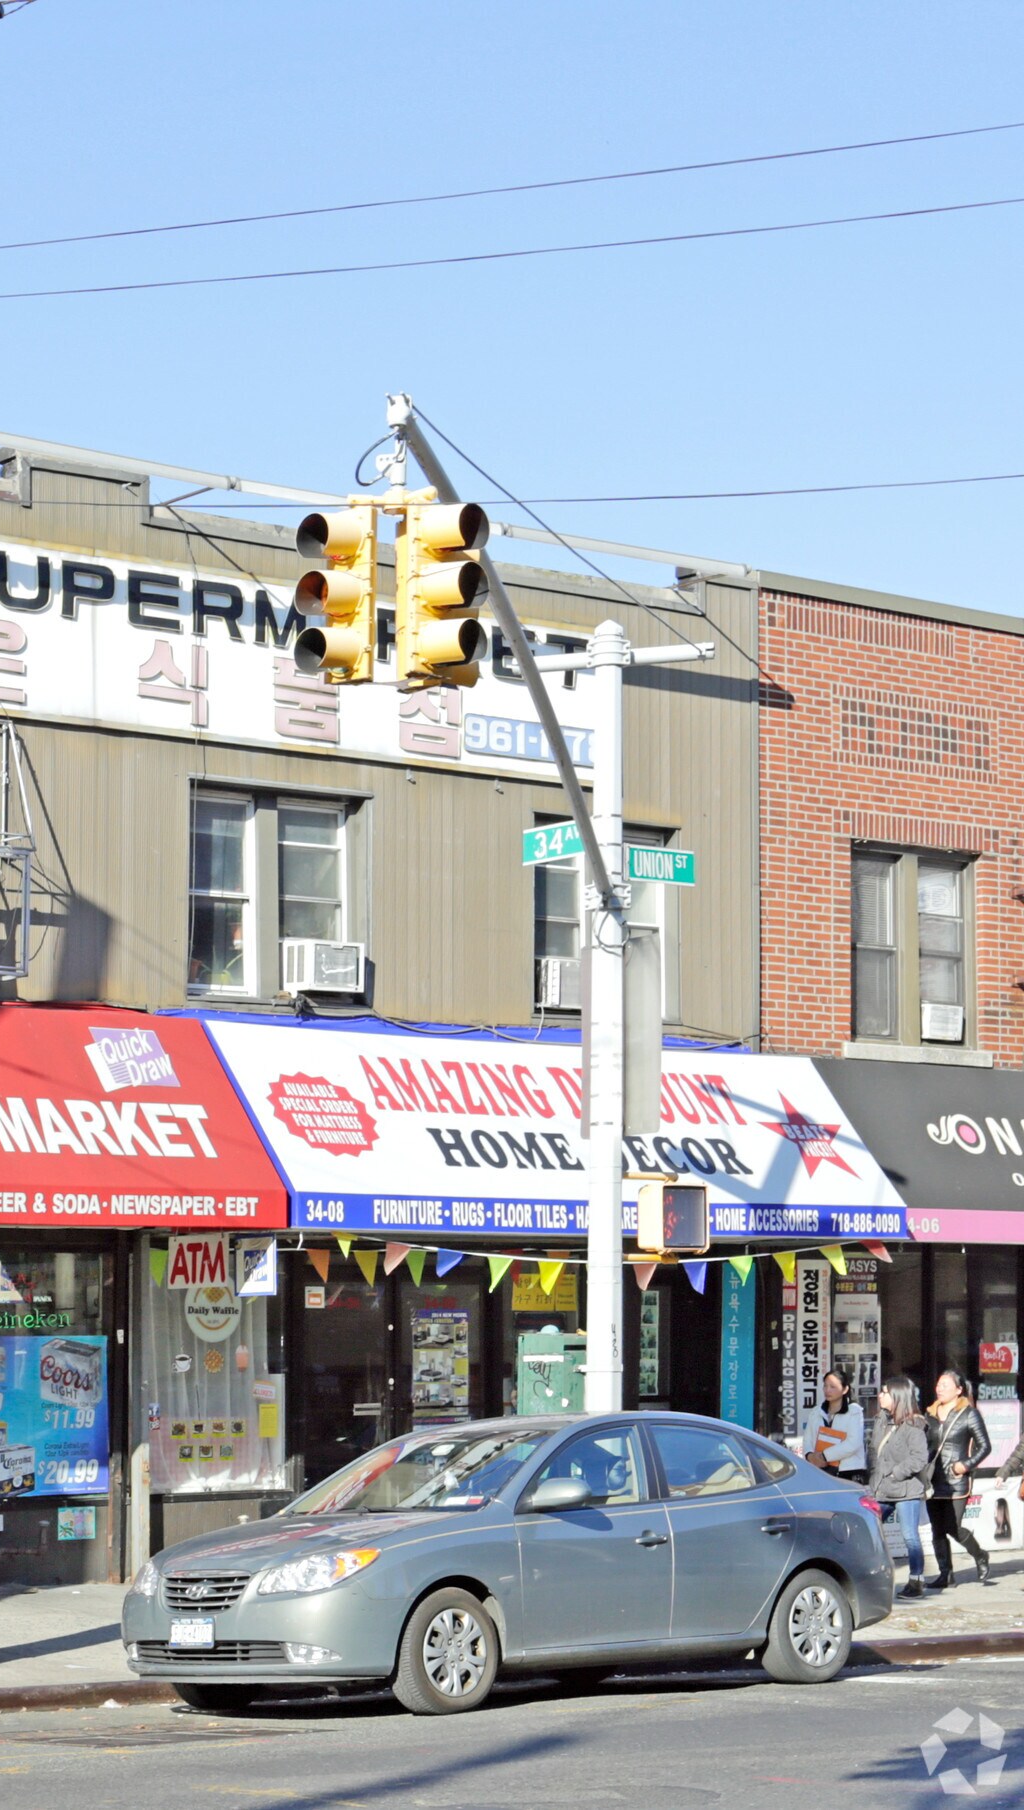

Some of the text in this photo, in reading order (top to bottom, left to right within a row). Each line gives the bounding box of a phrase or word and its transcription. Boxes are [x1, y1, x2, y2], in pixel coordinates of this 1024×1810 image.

[534, 829, 564, 859] 34
[634, 850, 688, 880] UNION ST
[100, 1027, 153, 1064] Quick
[126, 1051, 173, 1088] Draw
[282, 1082, 340, 1099] AVAILABLE
[359, 1055, 556, 1120] AMAZING
[278, 1096, 359, 1115] SPECIAL ORDERS
[291, 1112, 363, 1130] FOR MATTRESS
[780, 1123, 832, 1141] BEATS
[304, 1129, 369, 1146] & FURNITURE
[927, 1114, 1024, 1157] JON
[426, 1127, 754, 1176] HOME ECOR
[32, 1192, 47, 1213] &
[52, 1193, 102, 1215] SODA
[111, 1194, 216, 1217] NEWSPAPER
[225, 1197, 259, 1217] EBT
[306, 1199, 345, 1223] 34-08
[373, 1199, 443, 1226] FURNITURE
[451, 1202, 486, 1227] RUGS
[494, 1203, 533, 1228] FLOOR
[534, 1204, 568, 1229] TILES
[715, 1207, 750, 1232] HOME
[749, 1208, 819, 1233] ACCESSORIES
[831, 1212, 901, 1234] 718-886-0090
[170, 1240, 226, 1286] ATM
[187, 1305, 240, 1316] Daily Waffle
[39, 1355, 94, 1392] Coors
[782, 1314, 796, 1435] DRIVING SCHOOL
[51, 1385, 79, 1400] LIGHT
[978, 1383, 1018, 1400] SPECIAL
[44, 1408, 96, 1429] $11.99
[37, 1458, 99, 1485] $20.99
